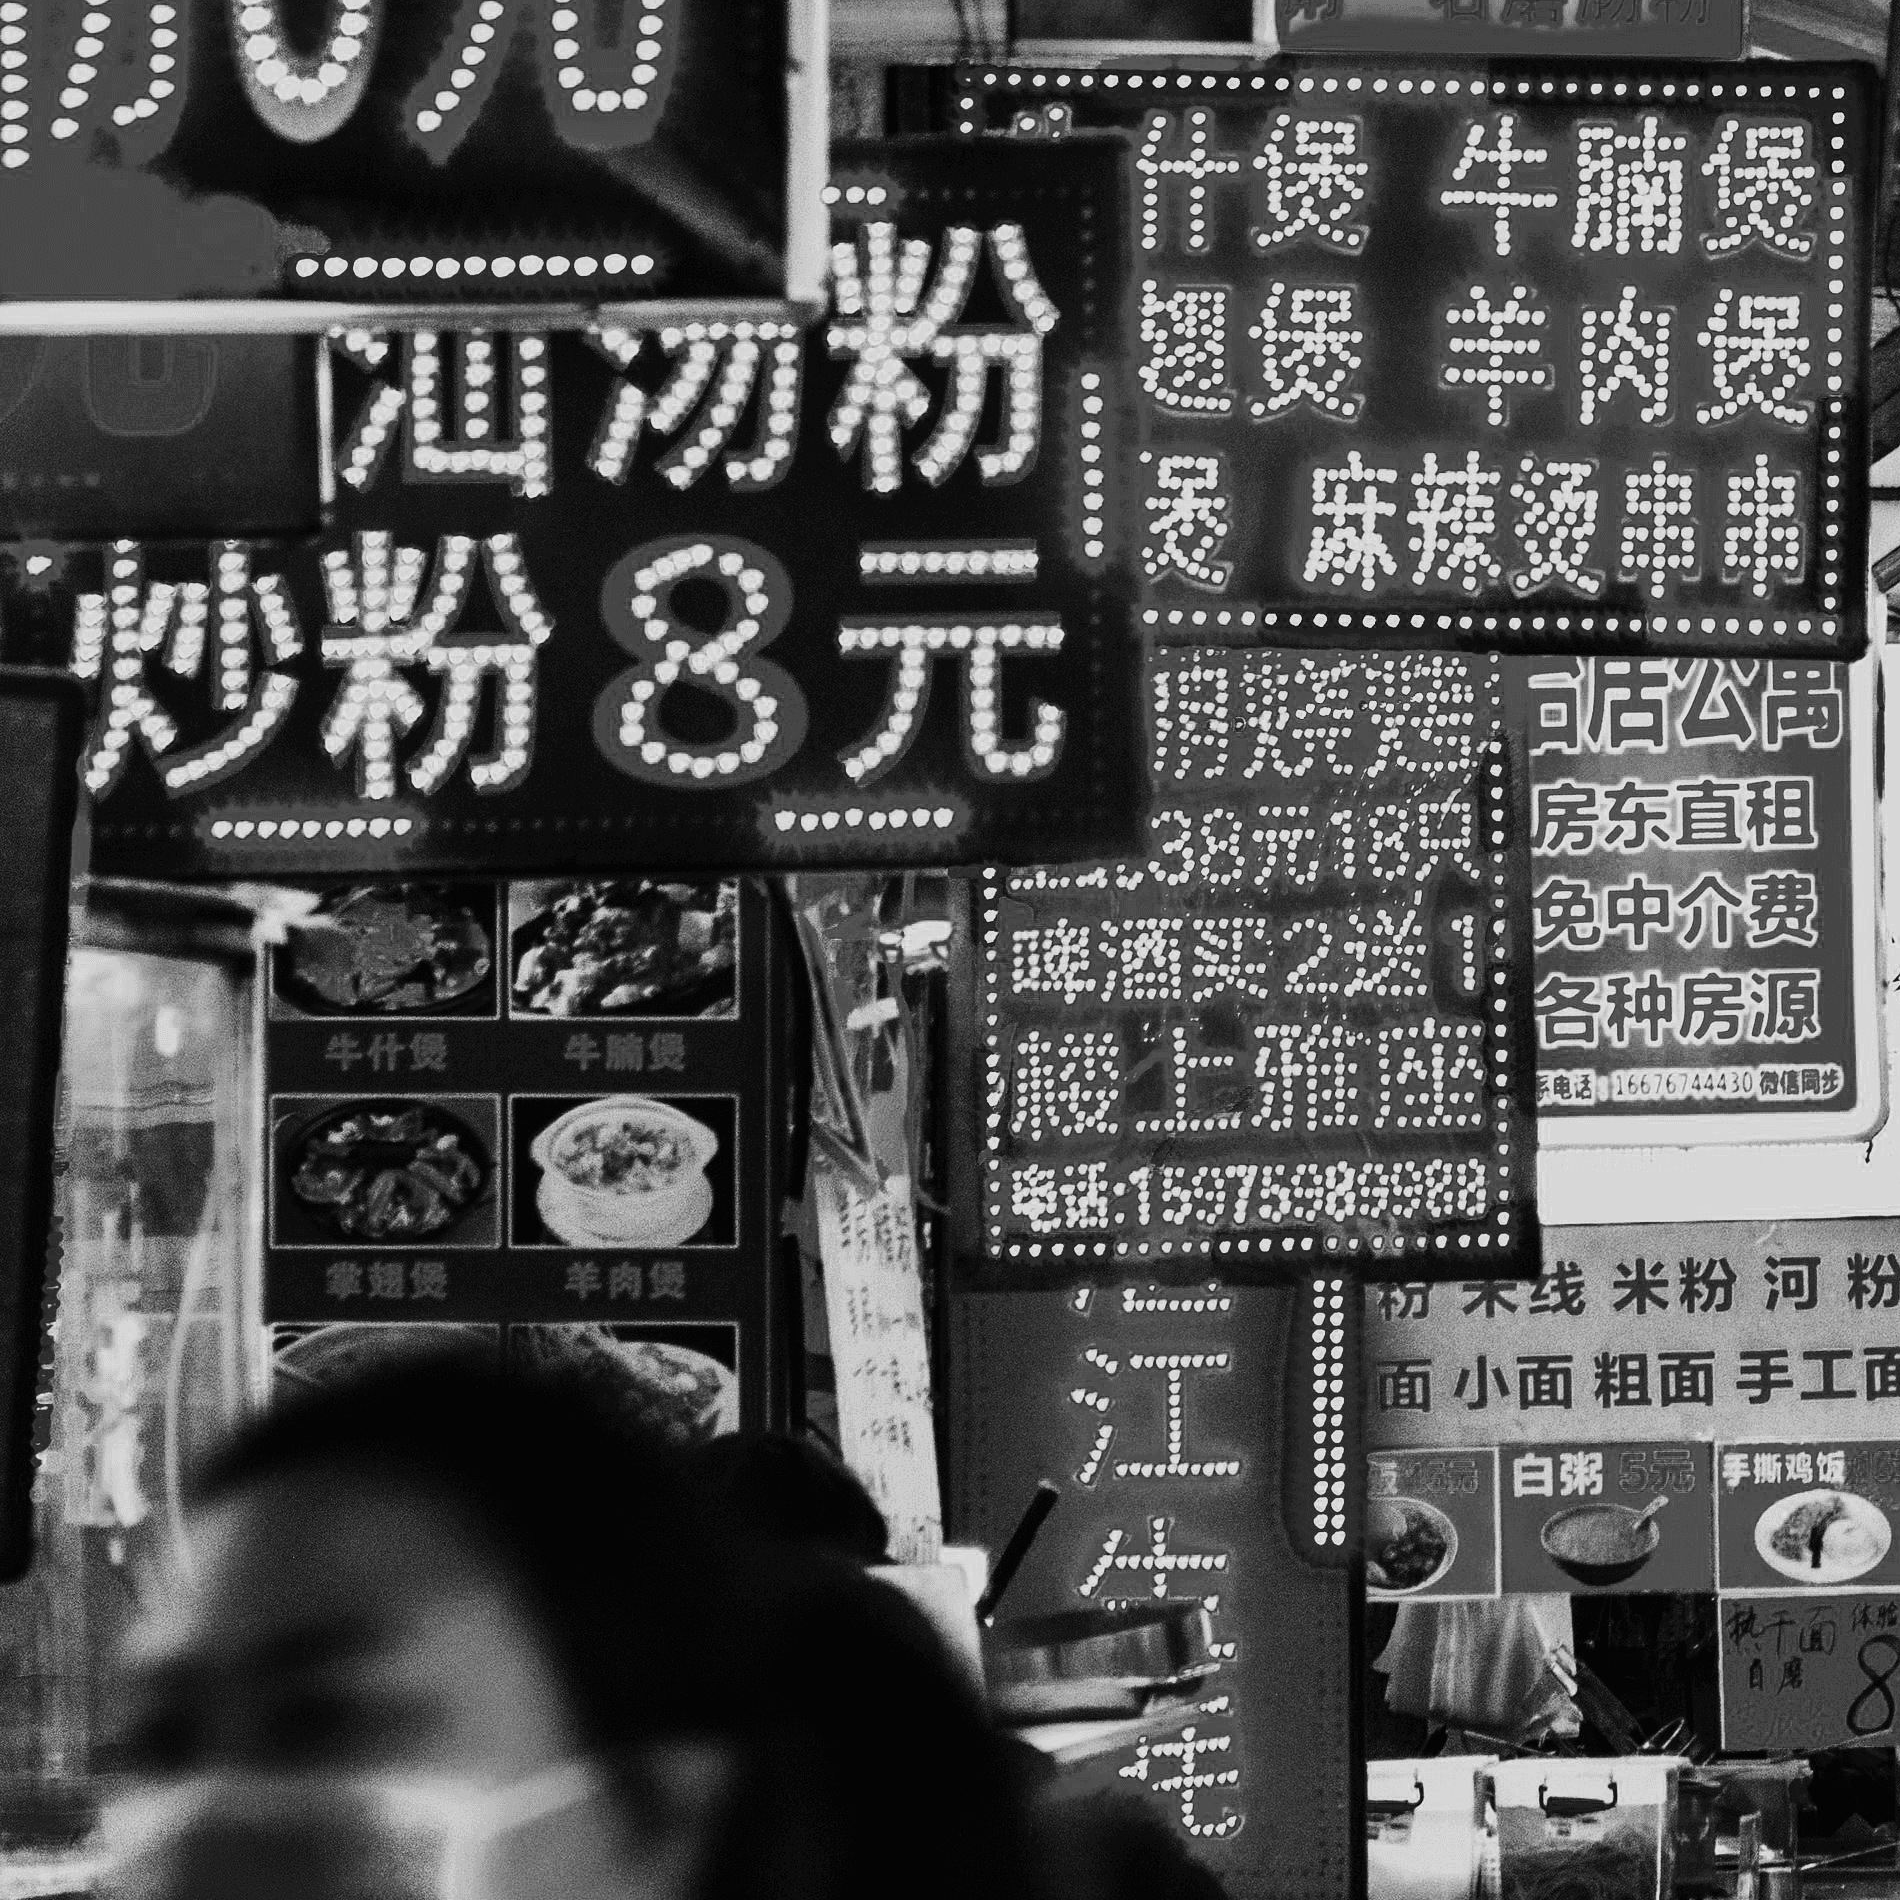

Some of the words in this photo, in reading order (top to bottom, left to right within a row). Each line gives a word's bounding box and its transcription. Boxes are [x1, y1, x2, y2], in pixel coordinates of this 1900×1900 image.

[1439, 110, 1816, 260] 牛腩煲
[1437, 284, 1812, 426] 羊肉煲
[1300, 450, 1806, 600] 麻辣烫串串
[68, 526, 1068, 803] 炒粉8元
[1532, 776, 1818, 857] 房东直租
[1533, 873, 1819, 951] 免中介费
[1012, 910, 1478, 1003] 啤酒买2送1
[1534, 966, 1822, 1048] 各种房源
[324, 1031, 448, 1073] 牛什煲
[562, 1031, 686, 1073] 牛腩煲
[1011, 1016, 1484, 1142] 楼上雅座
[1615, 1071, 1753, 1096] 16676744430
[1759, 1068, 1840, 1096] 微信同步
[563, 1261, 687, 1302] 羊肉煲
[1611, 1255, 1738, 1314] 米粉
[1453, 1352, 1574, 1411] 小面
[1593, 1349, 1716, 1409] 粗面
[1512, 1450, 1604, 1499] 白粥
[1618, 1449, 1695, 1496] 5元
[1721, 1450, 1846, 1494] 手撕鸡饭
